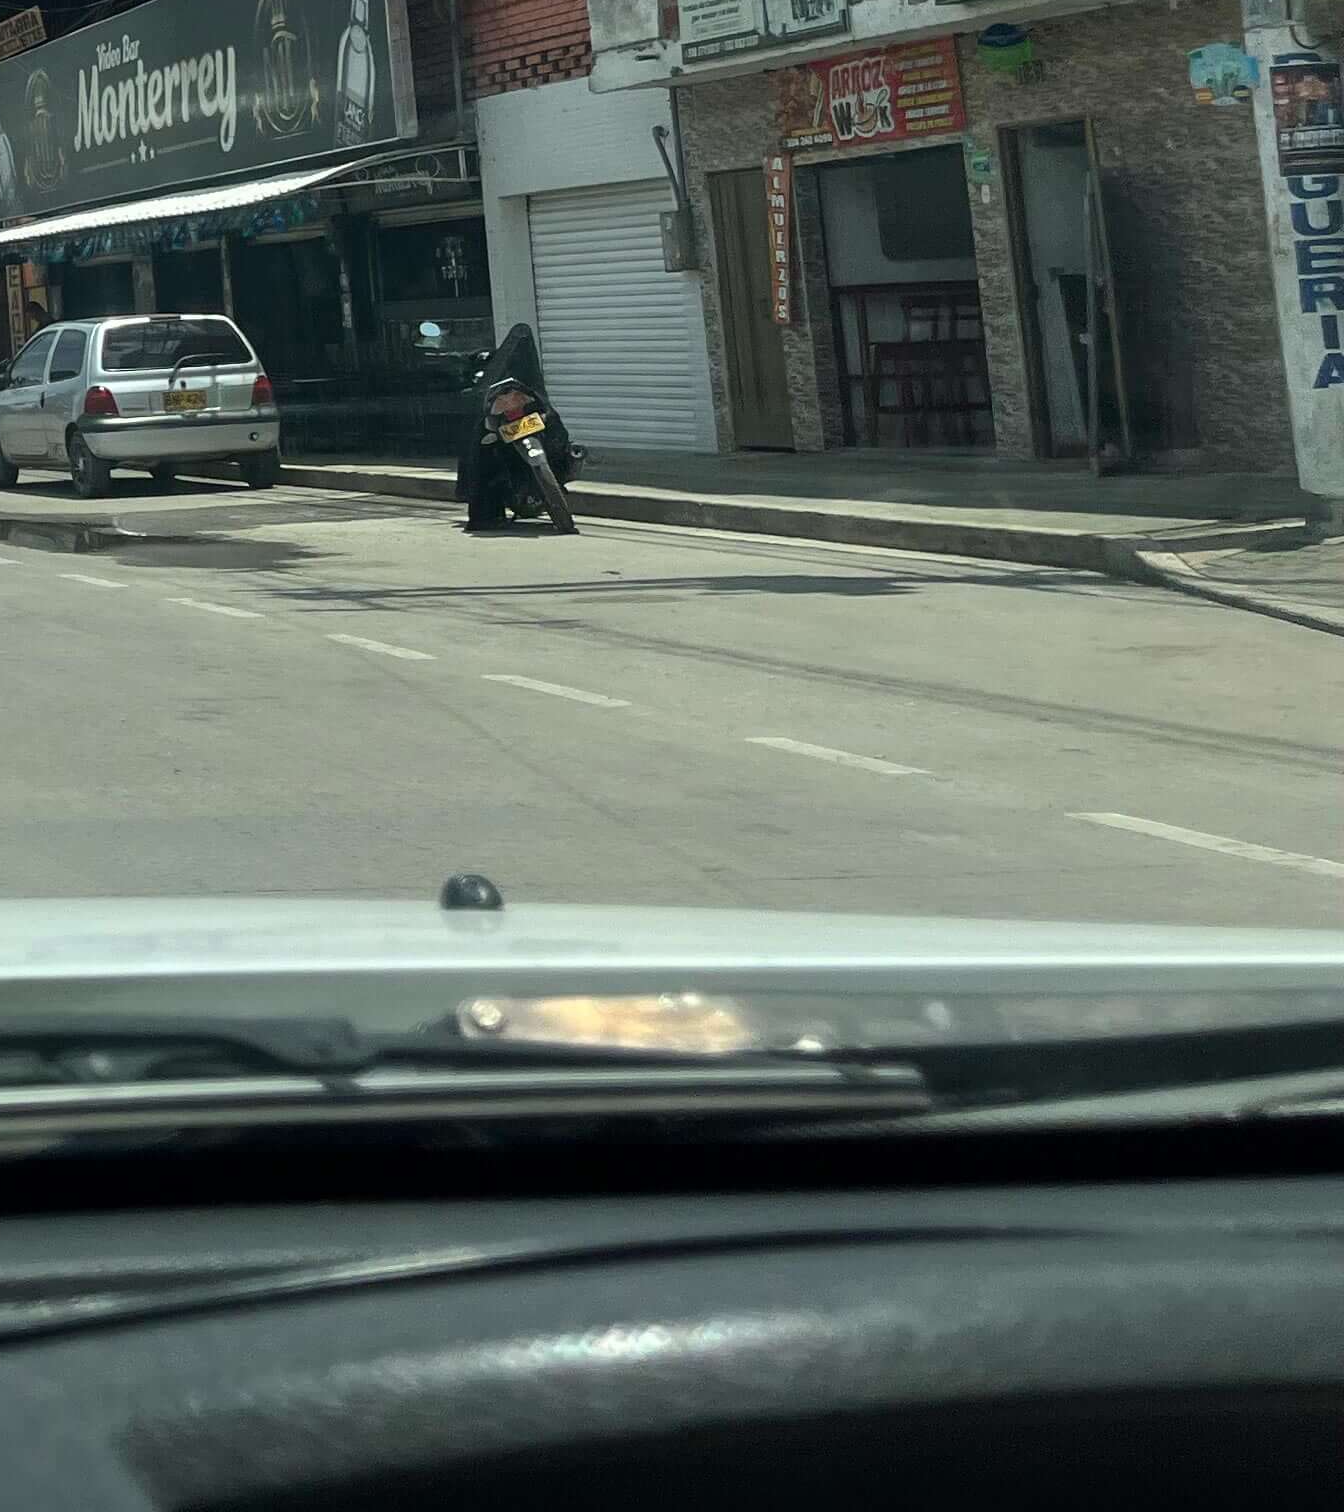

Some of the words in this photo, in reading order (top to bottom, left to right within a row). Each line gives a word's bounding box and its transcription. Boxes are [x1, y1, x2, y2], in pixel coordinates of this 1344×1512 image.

[96, 41, 120, 72] Video
[122, 34, 141, 64] Bar
[74, 46, 237, 152] Monterrey
